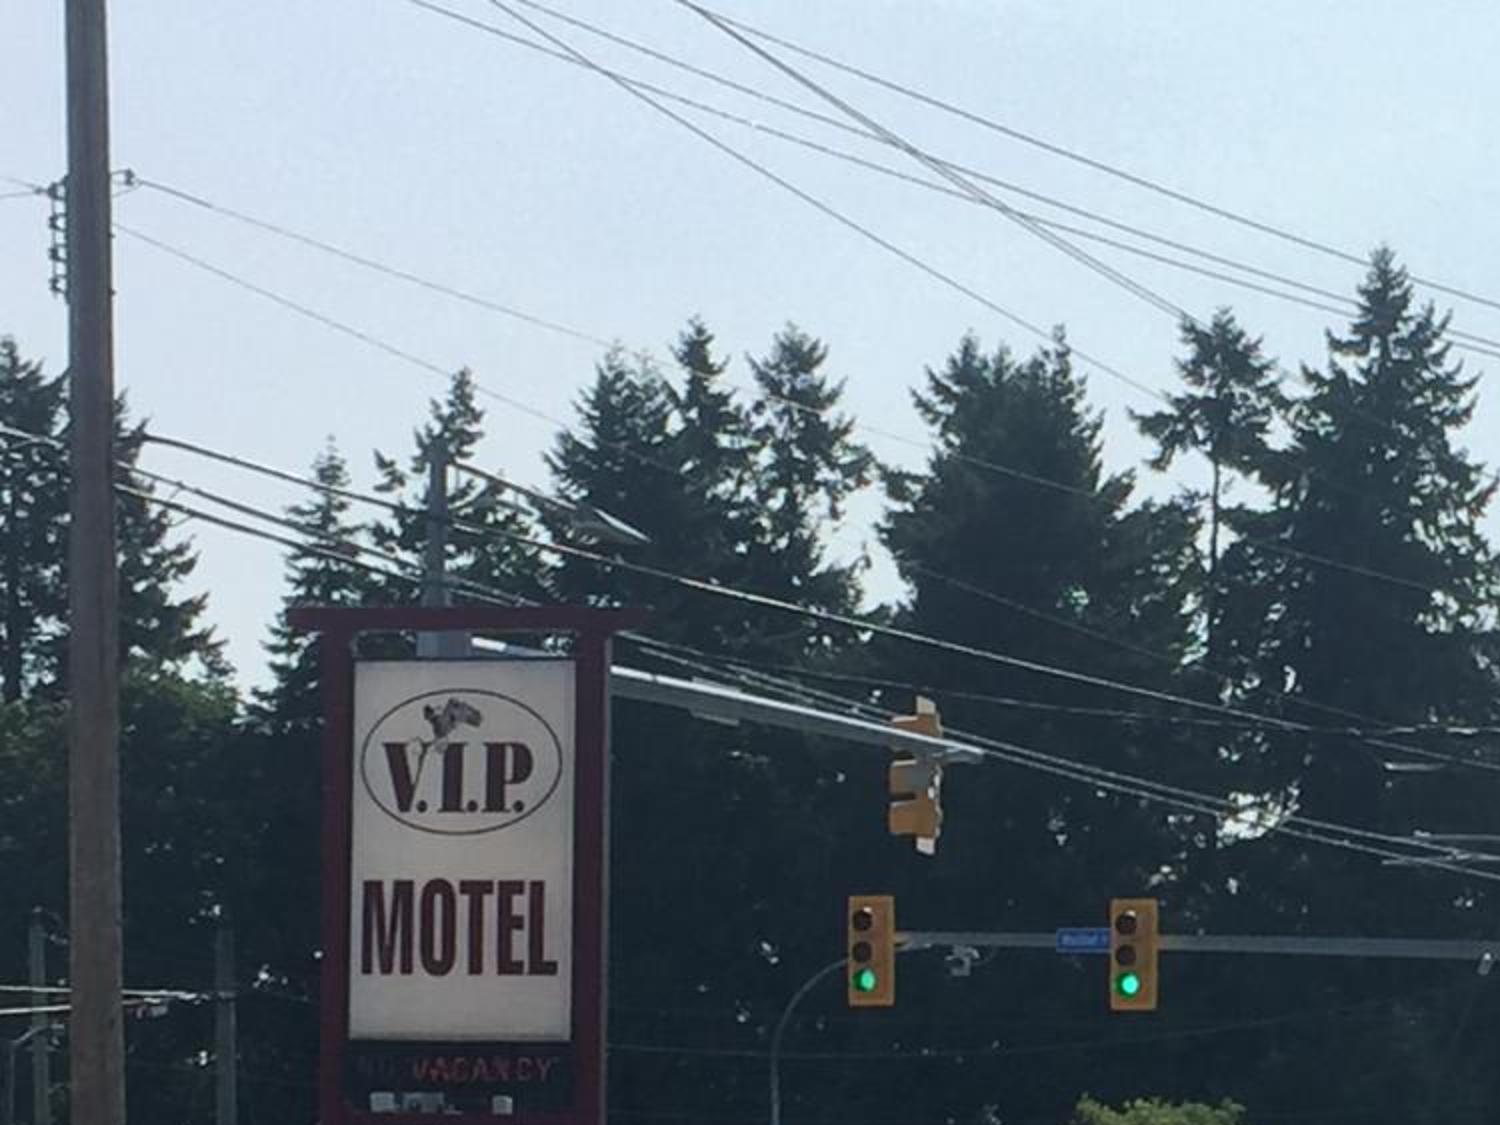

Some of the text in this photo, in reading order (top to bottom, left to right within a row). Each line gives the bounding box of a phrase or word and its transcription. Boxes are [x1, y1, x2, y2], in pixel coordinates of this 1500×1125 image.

[383, 742, 535, 813] V.I.P.
[361, 878, 558, 978] MOTEL
[413, 1057, 555, 1081] VACANCY
